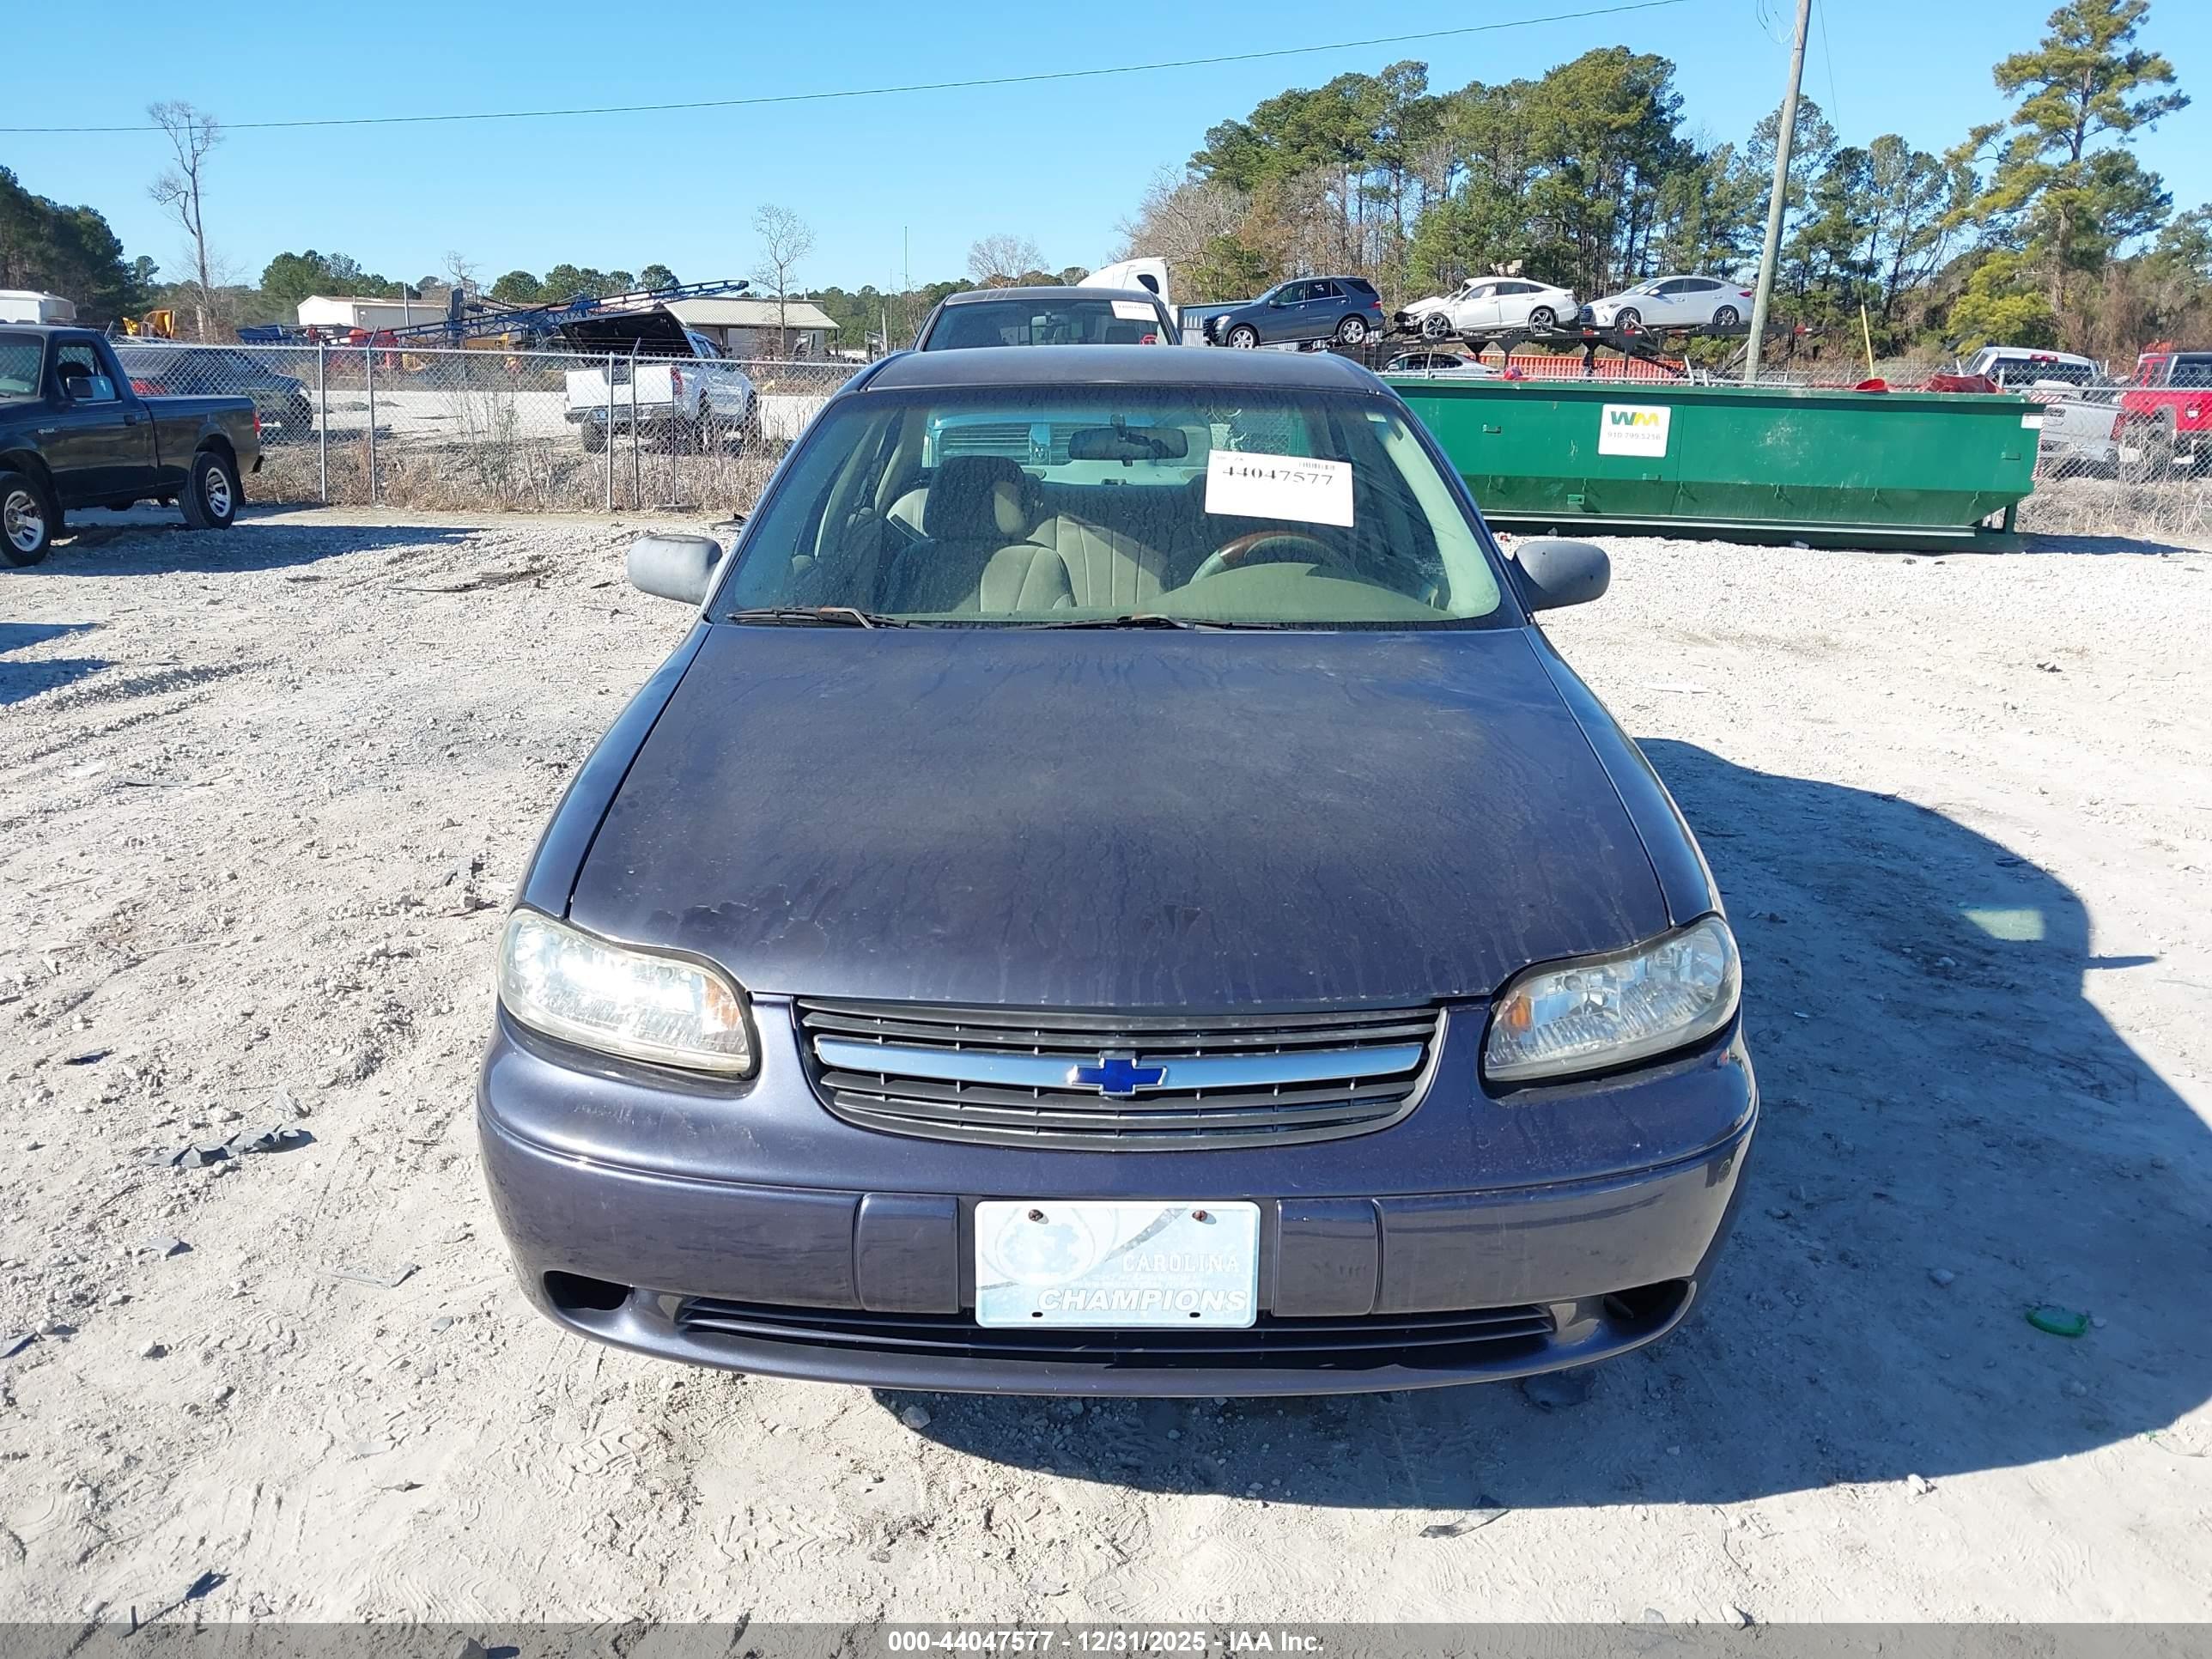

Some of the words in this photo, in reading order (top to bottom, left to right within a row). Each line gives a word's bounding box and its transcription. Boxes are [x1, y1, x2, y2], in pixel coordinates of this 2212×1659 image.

[1610, 410, 1660, 426] WM
[1223, 465, 1333, 486] 44047577
[1121, 1252, 1240, 1273] CAROLINA
[1037, 1288, 1249, 1312] CHAMPIONS
